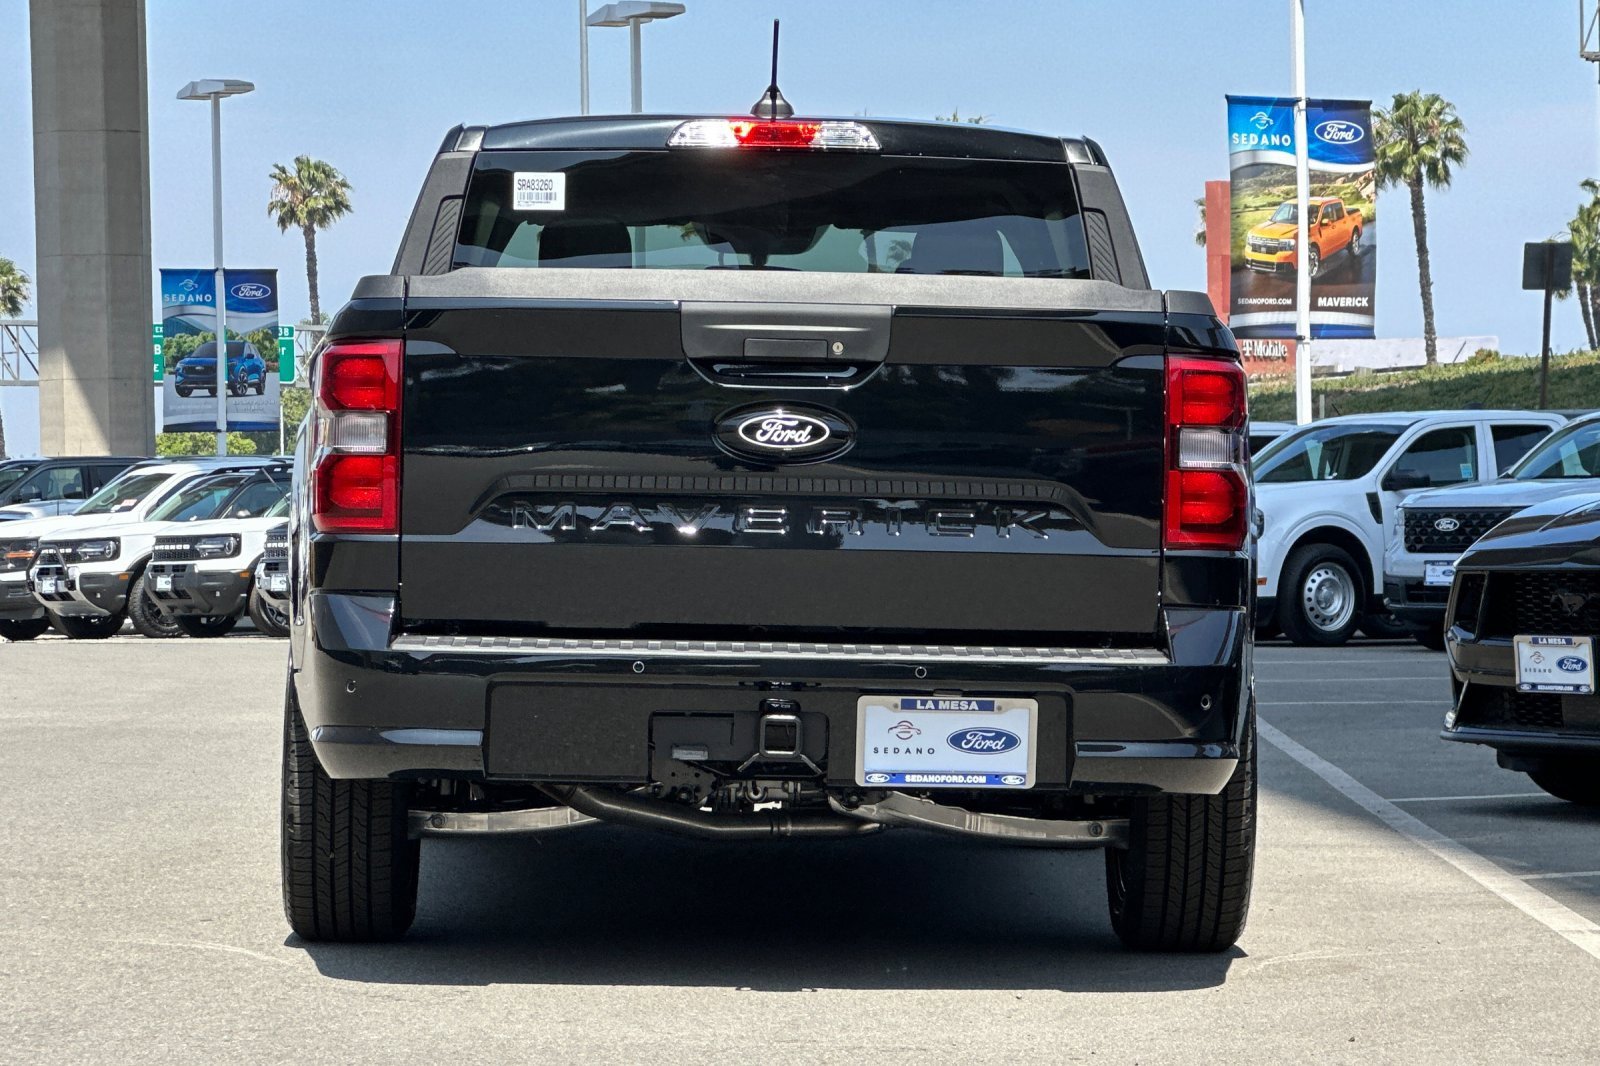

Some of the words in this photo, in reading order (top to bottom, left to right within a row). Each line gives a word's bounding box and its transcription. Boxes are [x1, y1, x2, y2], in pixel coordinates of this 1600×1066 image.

[1324, 123, 1354, 140] Ford
[1232, 133, 1291, 146] SEDANO
[517, 178, 553, 191] SRA83260
[239, 285, 263, 297] Ford
[163, 294, 212, 302] SEDANO
[1237, 297, 1292, 305] SEDANOFORD.COM
[1318, 297, 1369, 307] MAVERICK
[755, 418, 813, 443] Ford
[511, 501, 1050, 540] MAVERICK
[1562, 658, 1582, 671] Ford
[916, 699, 935, 710] LA
[938, 700, 979, 711] MESA
[961, 731, 1007, 750] Ford
[873, 746, 935, 755] SEDANO
[904, 774, 987, 784] SEDANOFORD.COM
